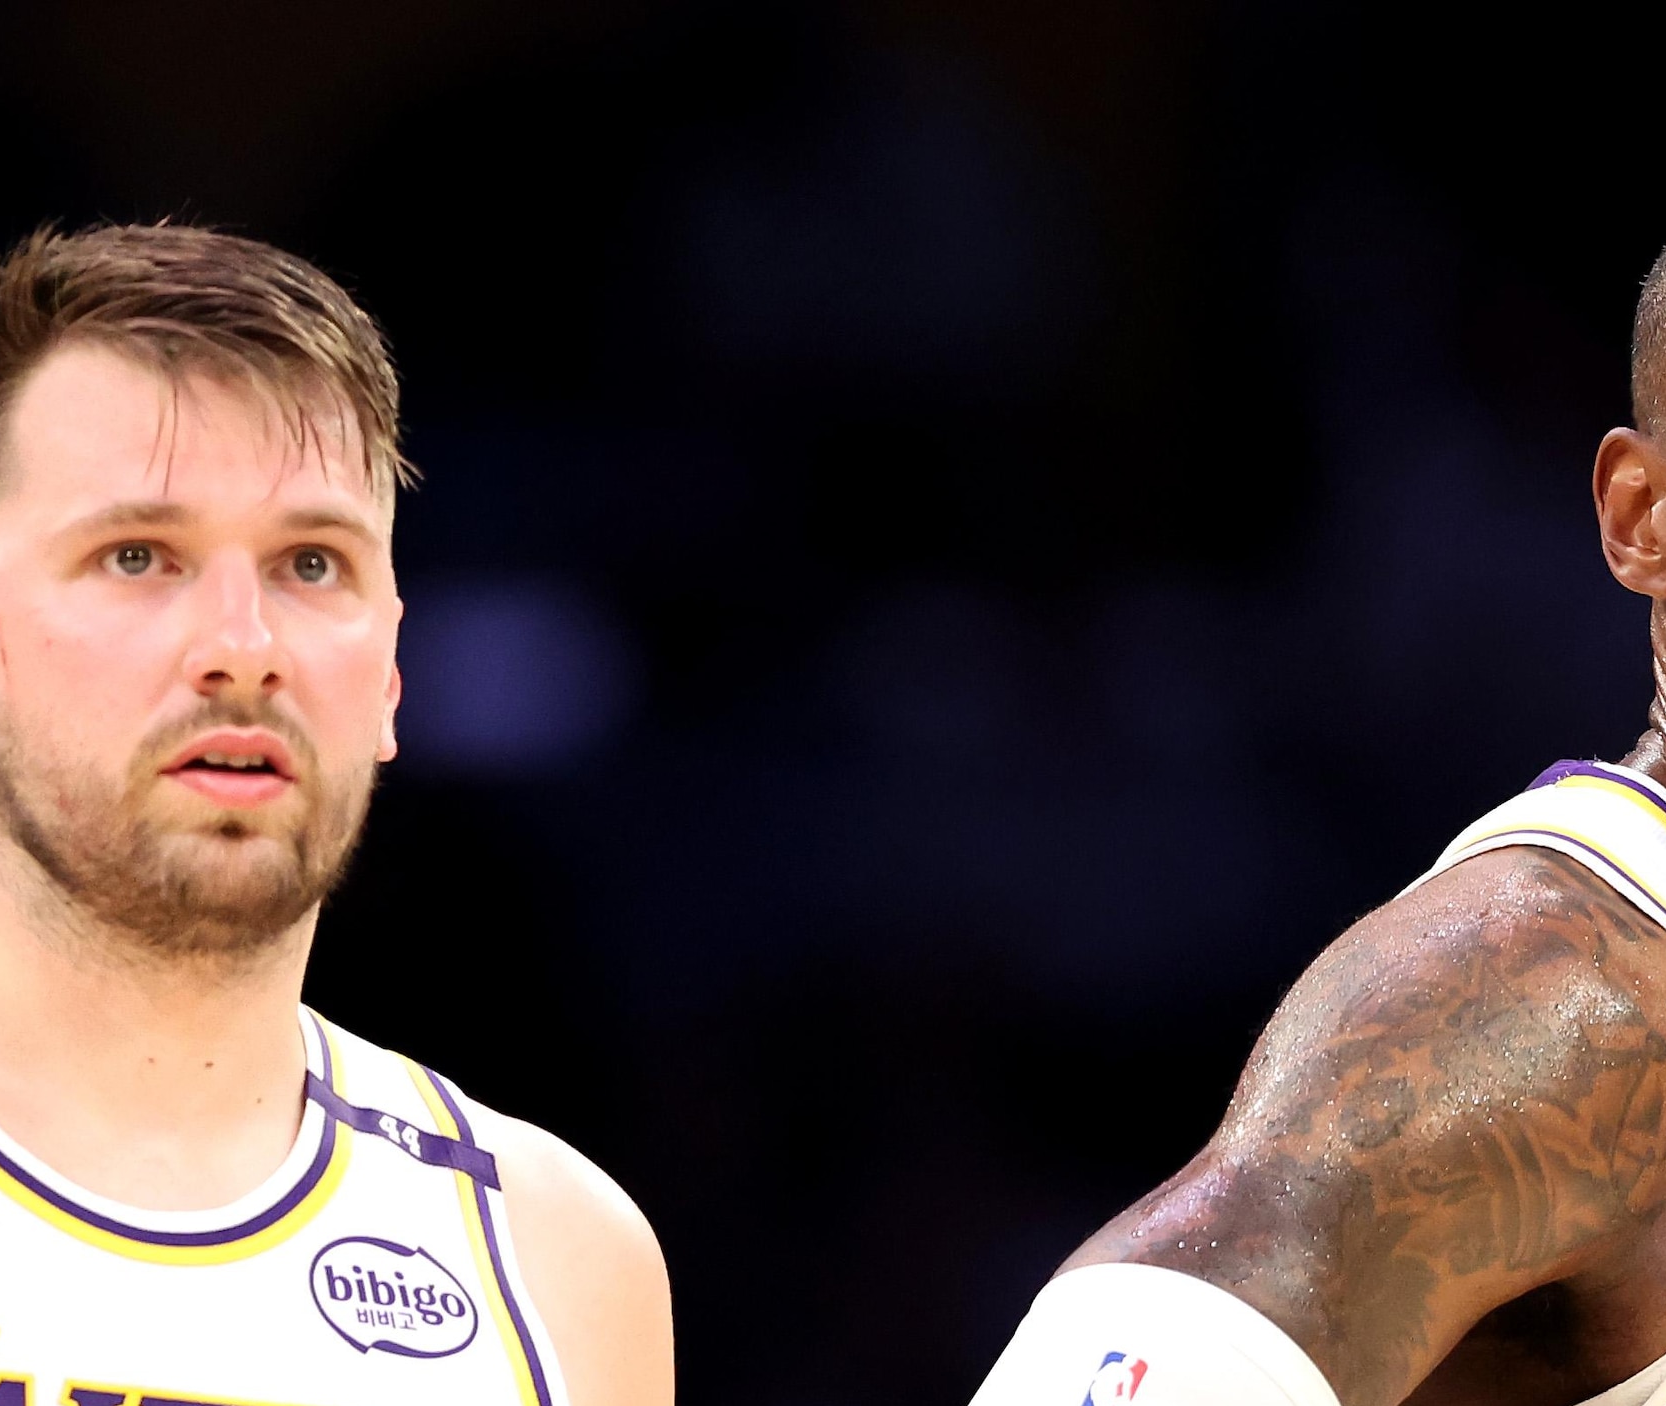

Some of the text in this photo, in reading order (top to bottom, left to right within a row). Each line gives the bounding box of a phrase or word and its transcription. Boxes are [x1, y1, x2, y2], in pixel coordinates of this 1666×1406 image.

[378, 1114, 422, 1158] 44
[323, 1265, 466, 1325] bibigo
[355, 1307, 418, 1331] 비비고
